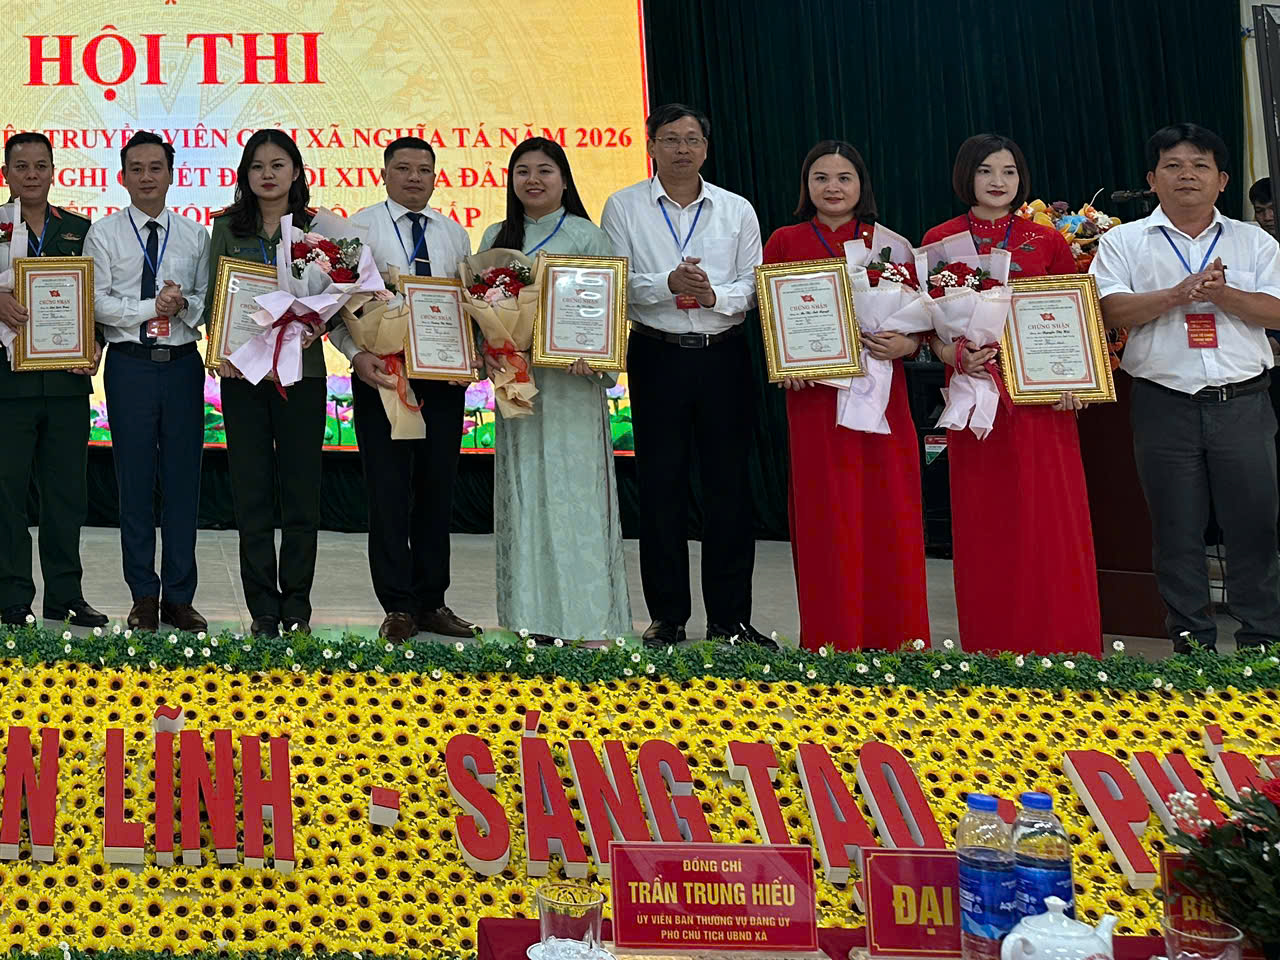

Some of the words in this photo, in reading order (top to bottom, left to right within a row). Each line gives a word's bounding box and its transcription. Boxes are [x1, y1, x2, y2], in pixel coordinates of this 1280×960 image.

[22, 24, 168, 102] HỘI
[186, 32, 326, 85] THI
[44, 122, 156, 149] TRUYỀ
[161, 122, 228, 149] VIÊN
[306, 123, 345, 148] XÃ
[452, 122, 493, 148] TÁ
[575, 127, 632, 148] 2026
[51, 167, 108, 192] GHỊ
[457, 161, 508, 188] ĐẢ
[104, 704, 296, 871] LĨNH
[445, 710, 713, 878] SÁNG
[628, 874, 678, 904] TRẦN
[683, 882, 745, 905] TRUNG
[751, 876, 795, 906] HIẾU
[674, 915, 694, 925] BAN
[892, 884, 954, 935] ĐẠI
[726, 931, 752, 941] UBND
